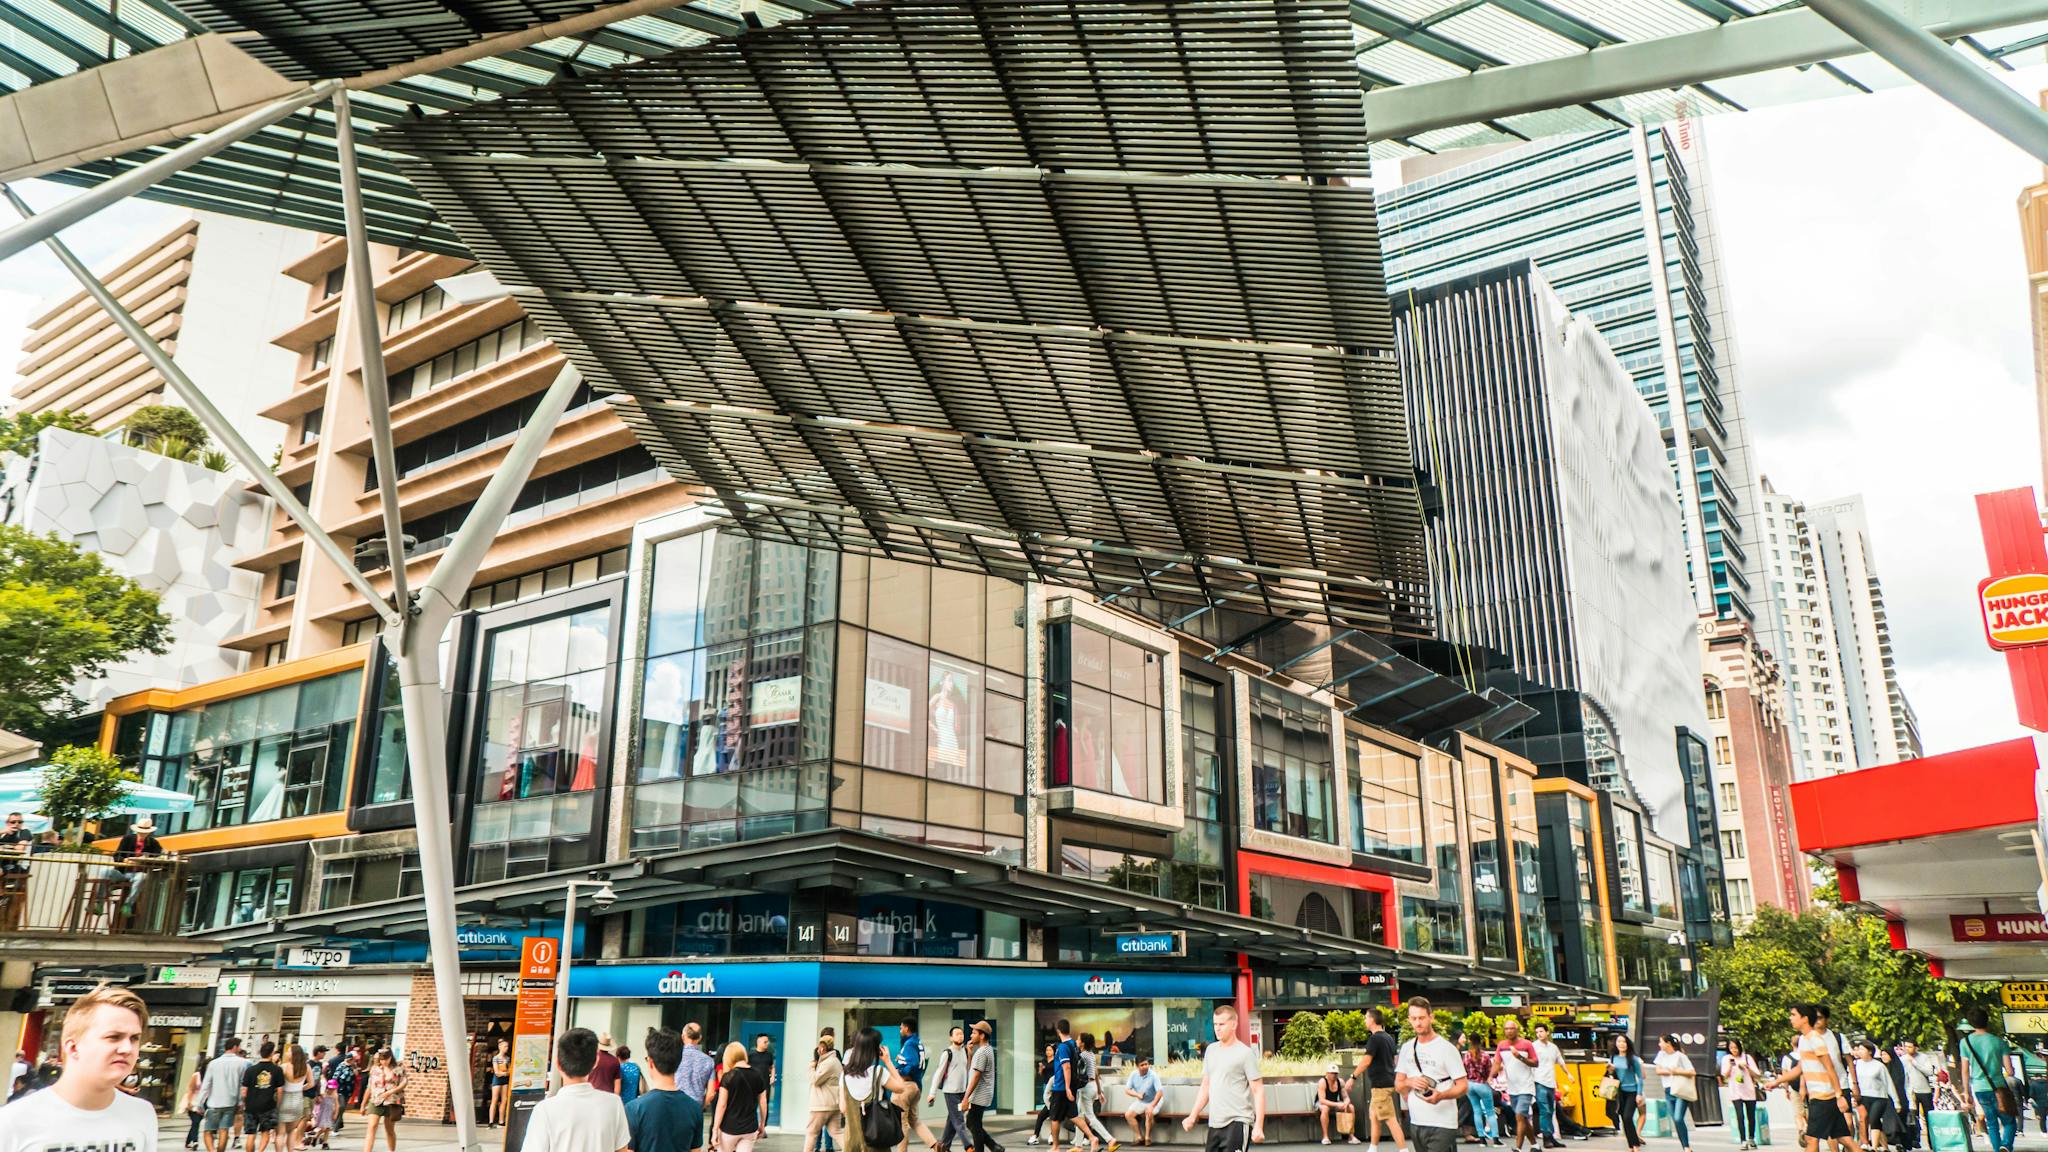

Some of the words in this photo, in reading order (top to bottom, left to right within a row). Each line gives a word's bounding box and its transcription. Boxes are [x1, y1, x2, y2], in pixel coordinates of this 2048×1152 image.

[457, 931, 507, 944] citibank
[798, 926, 815, 941] 141
[835, 926, 850, 942] 141
[1121, 938, 1168, 952] citibank
[303, 949, 342, 965] Typo
[273, 979, 340, 992] PHARMACY
[658, 971, 716, 994] citibank
[1084, 976, 1123, 995] citibank
[1369, 974, 1386, 984] nab
[410, 1051, 438, 1073] Typo
